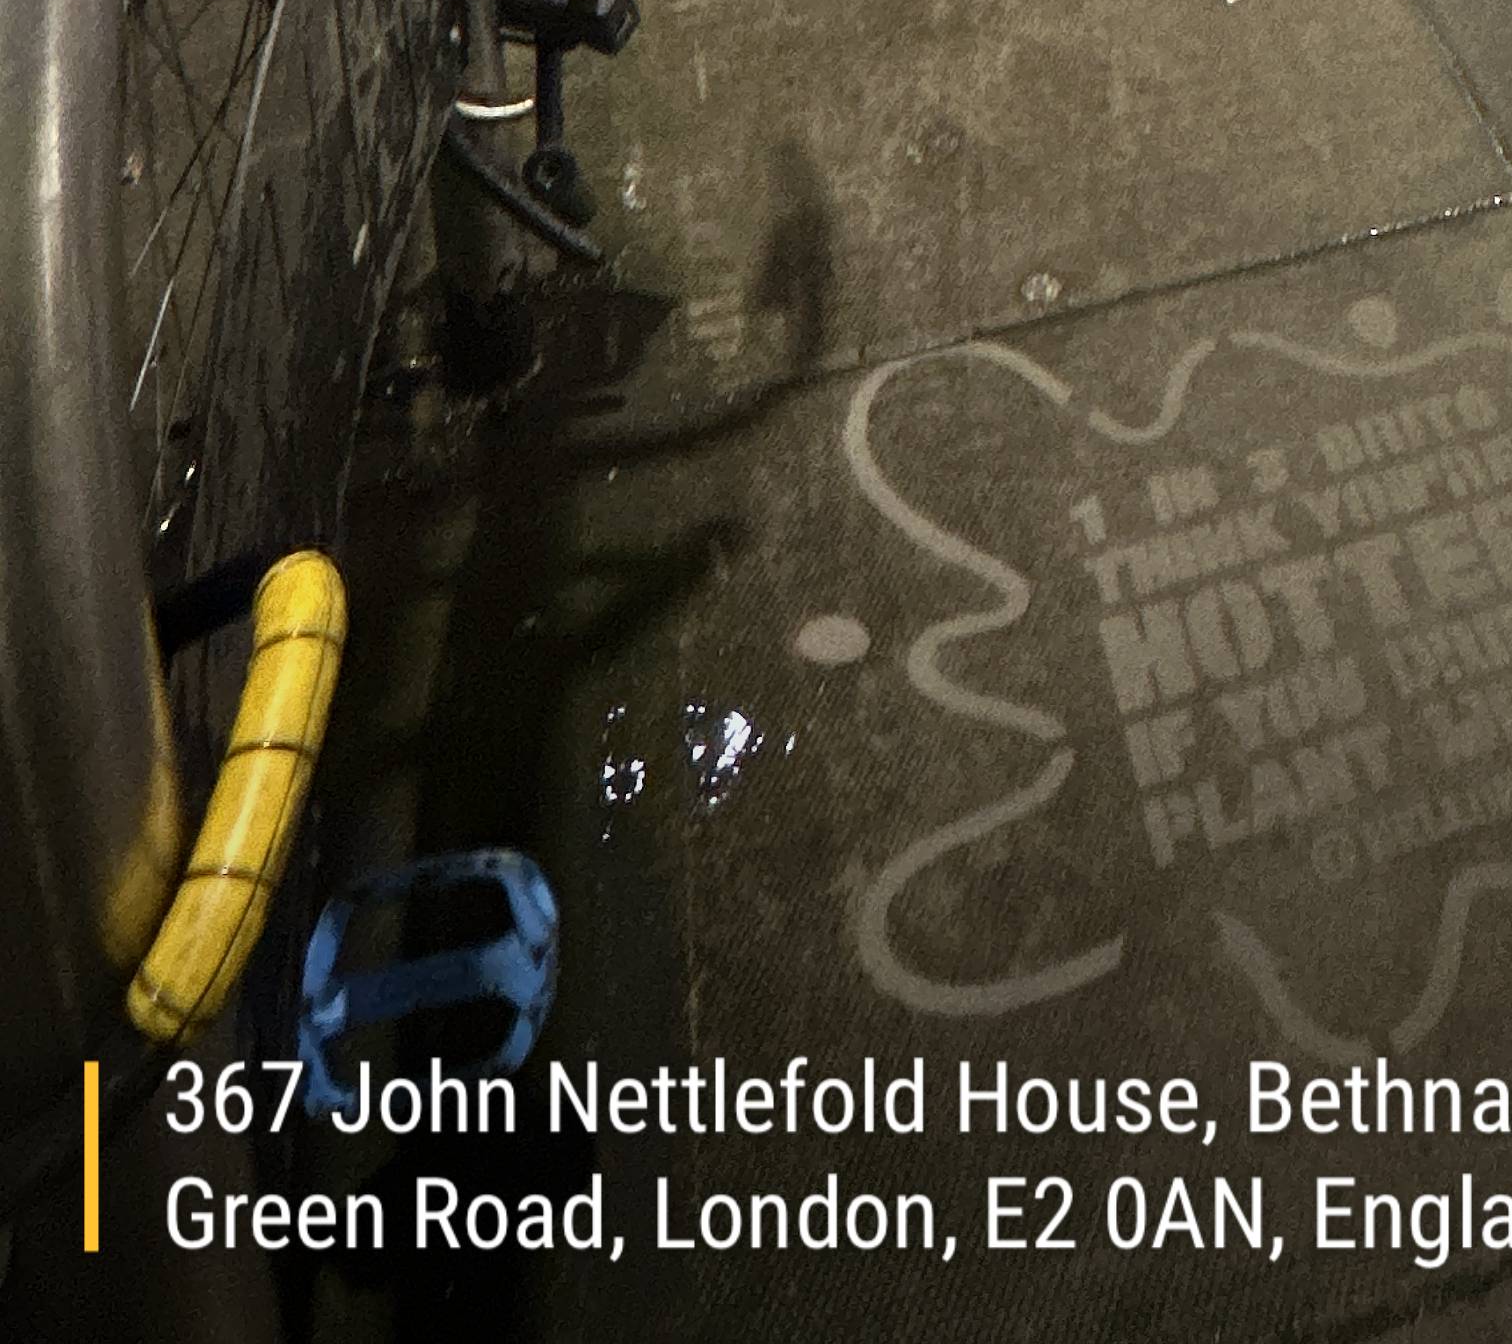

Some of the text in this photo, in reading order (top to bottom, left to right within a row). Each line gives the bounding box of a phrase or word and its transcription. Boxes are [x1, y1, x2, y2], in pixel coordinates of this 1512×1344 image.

[1084, 501, 1291, 605] THINK
[1149, 465, 1220, 523] IN
[1124, 709, 1196, 788] IF
[1216, 654, 1370, 751] YOU
[1141, 722, 1392, 869] PLANT
